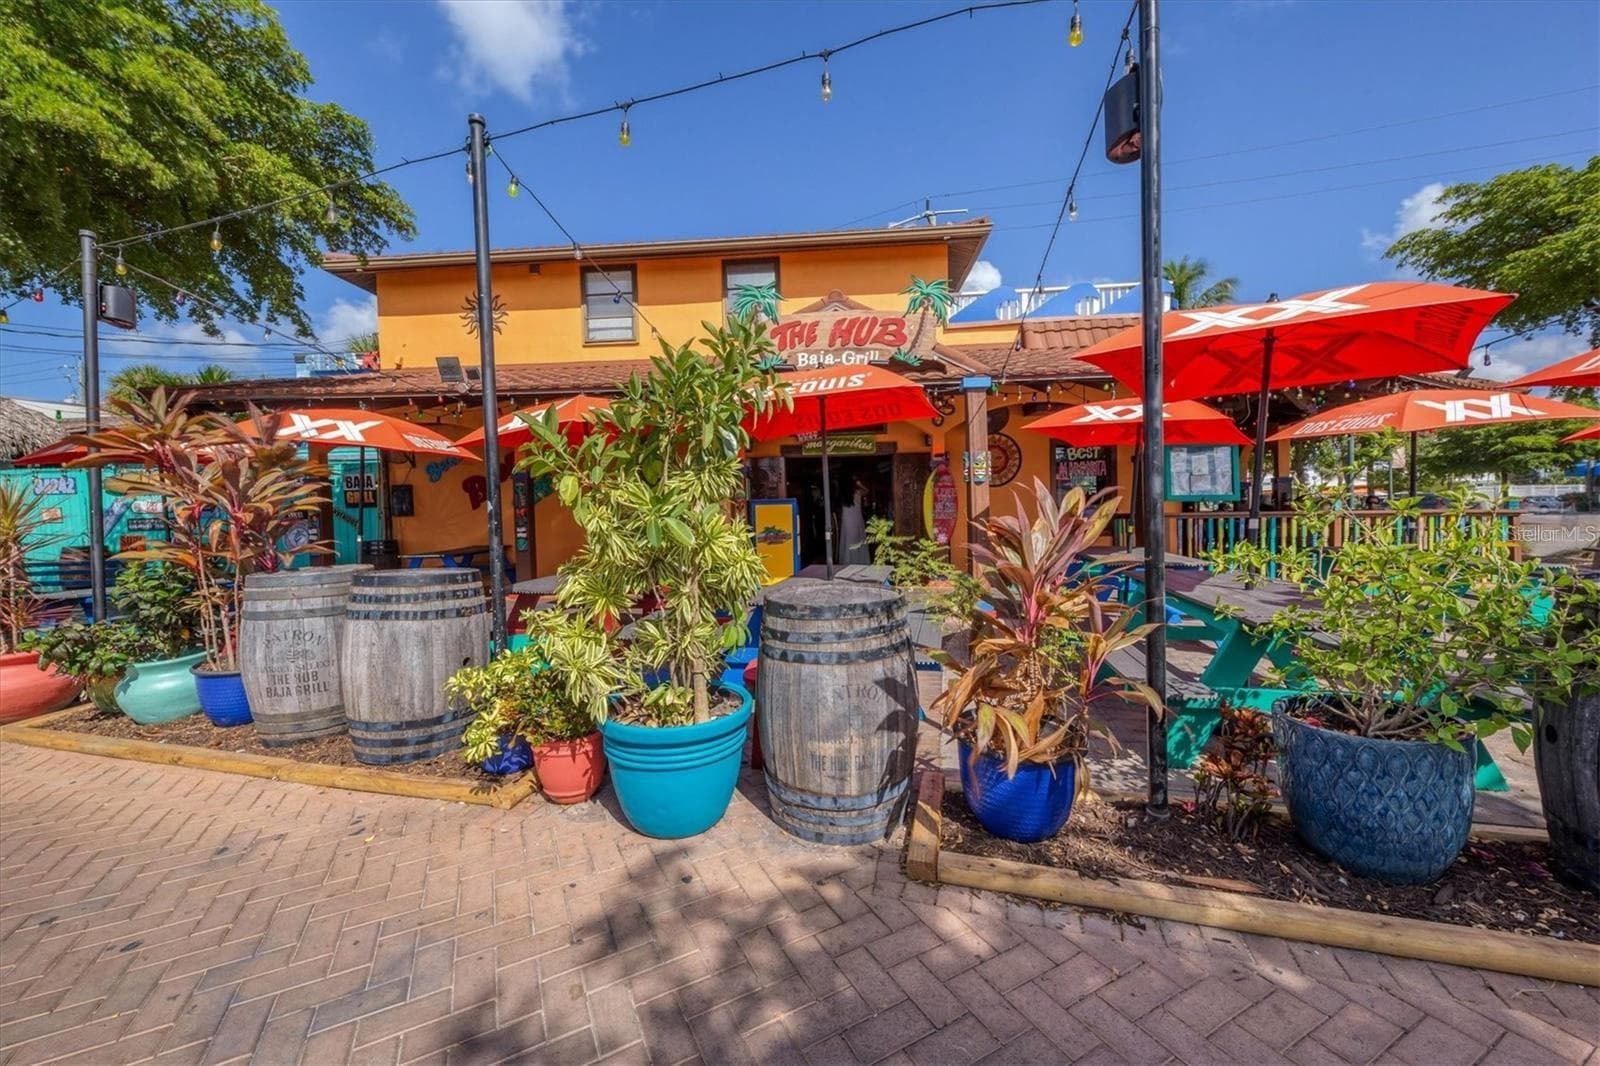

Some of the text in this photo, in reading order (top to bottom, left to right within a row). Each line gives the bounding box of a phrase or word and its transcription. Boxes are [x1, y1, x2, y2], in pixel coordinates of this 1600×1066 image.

[770, 316, 909, 352] THE HUB
[796, 350, 879, 369] Baja-Grill
[1413, 392, 1548, 423] XX
[276, 413, 384, 442] XX
[1066, 446, 1101, 460] BEST
[345, 475, 374, 489] BAA
[346, 490, 375, 504] GRLL
[270, 670, 319, 686] THE HUB
[265, 681, 330, 699] BAJA GRILL
